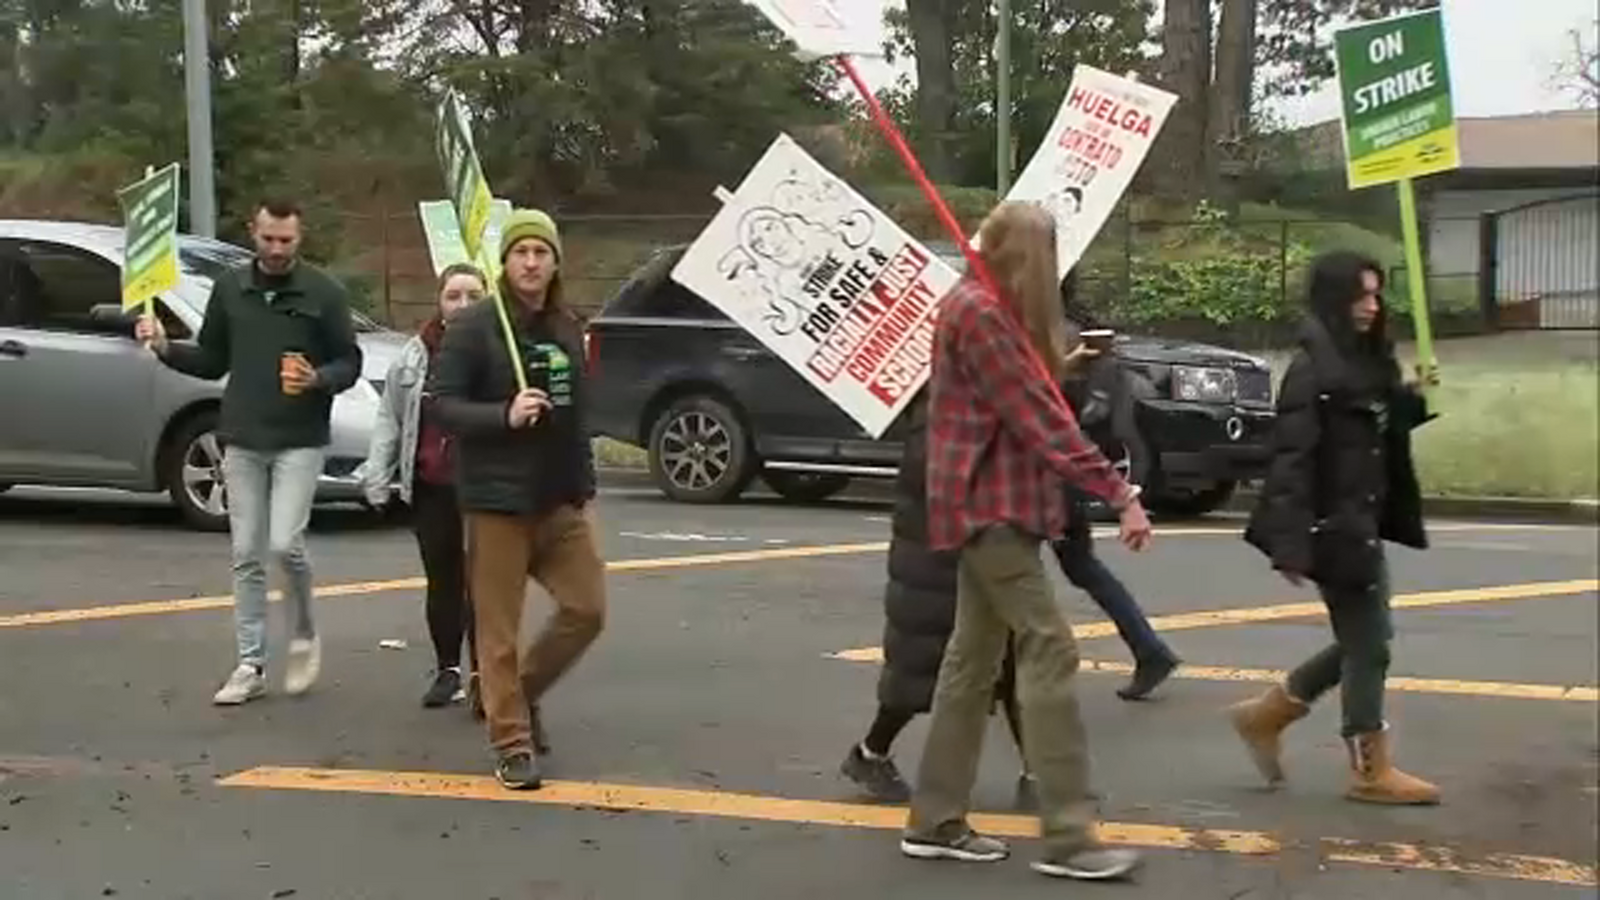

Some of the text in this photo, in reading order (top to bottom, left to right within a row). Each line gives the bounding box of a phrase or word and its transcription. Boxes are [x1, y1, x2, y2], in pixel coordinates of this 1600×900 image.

[1369, 30, 1403, 64] ON
[1067, 86, 1154, 138] HUELGA
[1353, 61, 1437, 114] STRIKE
[800, 301, 842, 343] FOR
[828, 259, 875, 310] SAFE
[866, 245, 889, 267] &
[801, 252, 847, 300] STRIKE
[808, 246, 926, 378] RACIALLY JUST
[845, 280, 938, 385] COMMUNITY
[875, 307, 942, 399] SCHOO
